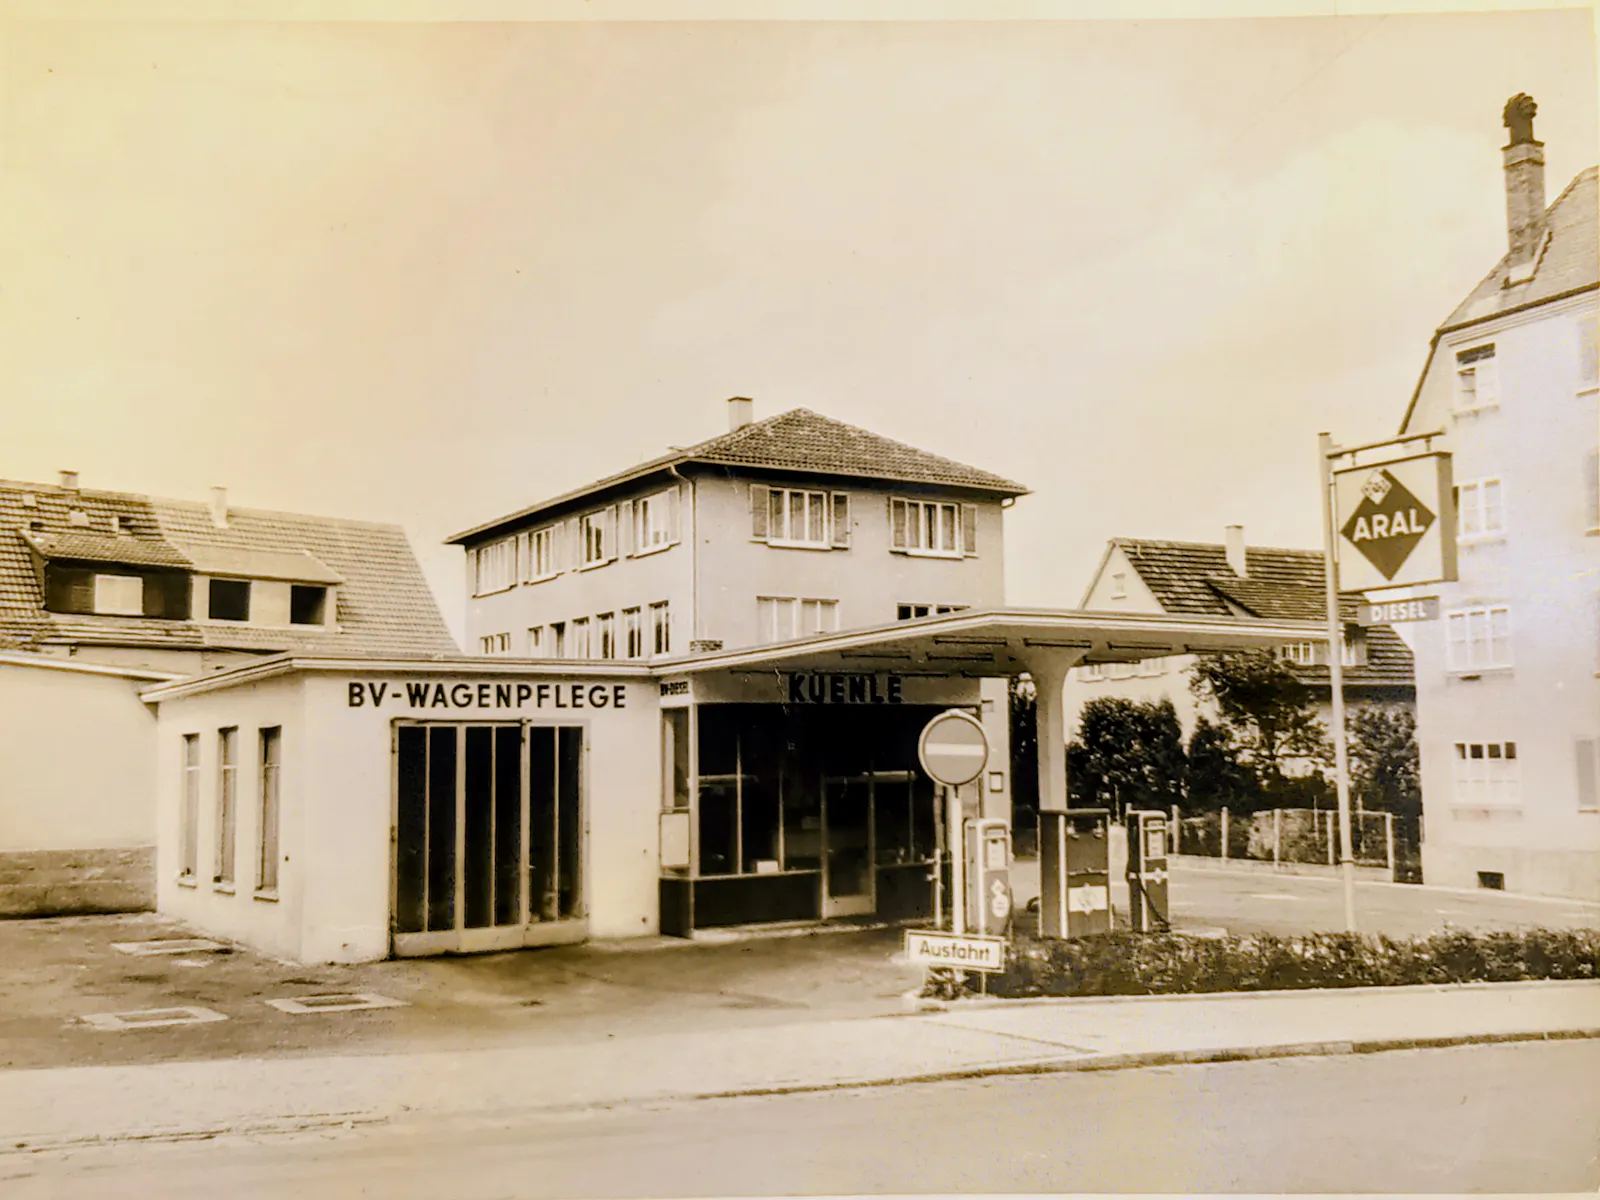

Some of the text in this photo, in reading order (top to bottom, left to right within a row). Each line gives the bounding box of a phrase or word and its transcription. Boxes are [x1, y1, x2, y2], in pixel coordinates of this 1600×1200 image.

[1353, 508, 1425, 542] ARAL
[1371, 602, 1427, 622] DIESEL
[348, 682, 626, 708] BV-WAGENPFLEGE
[789, 675, 902, 703] KUENLE
[919, 940, 990, 961] Ausfahrt
